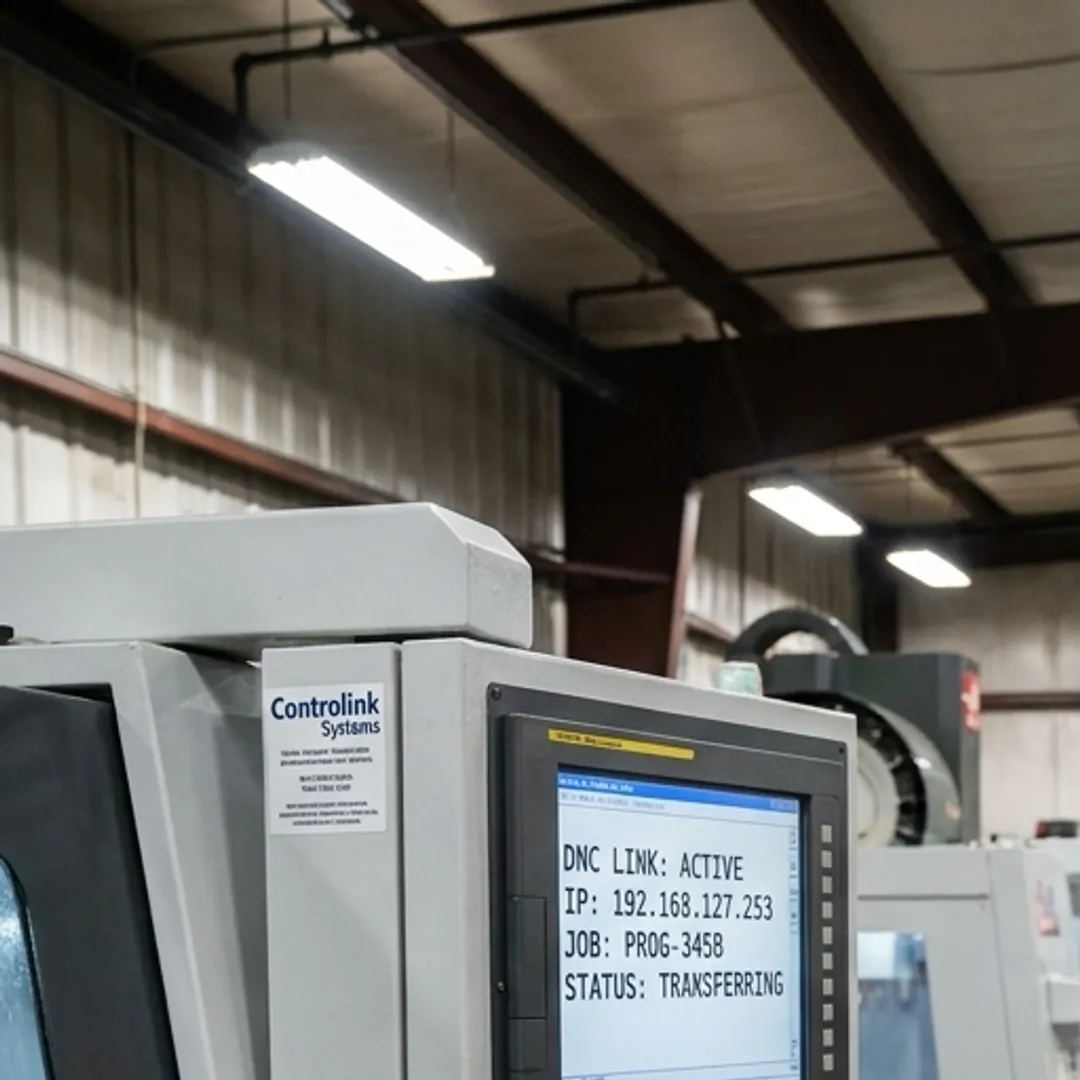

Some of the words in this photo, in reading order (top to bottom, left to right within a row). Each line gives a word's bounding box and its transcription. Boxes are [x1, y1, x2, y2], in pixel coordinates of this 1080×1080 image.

[271, 691, 380, 720] Controlink
[321, 720, 381, 740] Systems
[563, 844, 600, 873] DNC
[613, 847, 667, 877] LINK:
[679, 852, 744, 881] ACTIVE
[565, 887, 598, 915] IP:
[613, 889, 774, 921] 192.168.127.253
[564, 930, 609, 959] JOB:
[624, 930, 724, 959] PROG-3458
[565, 972, 645, 1001] STATUS:
[658, 971, 784, 999] TRANSFERRING
